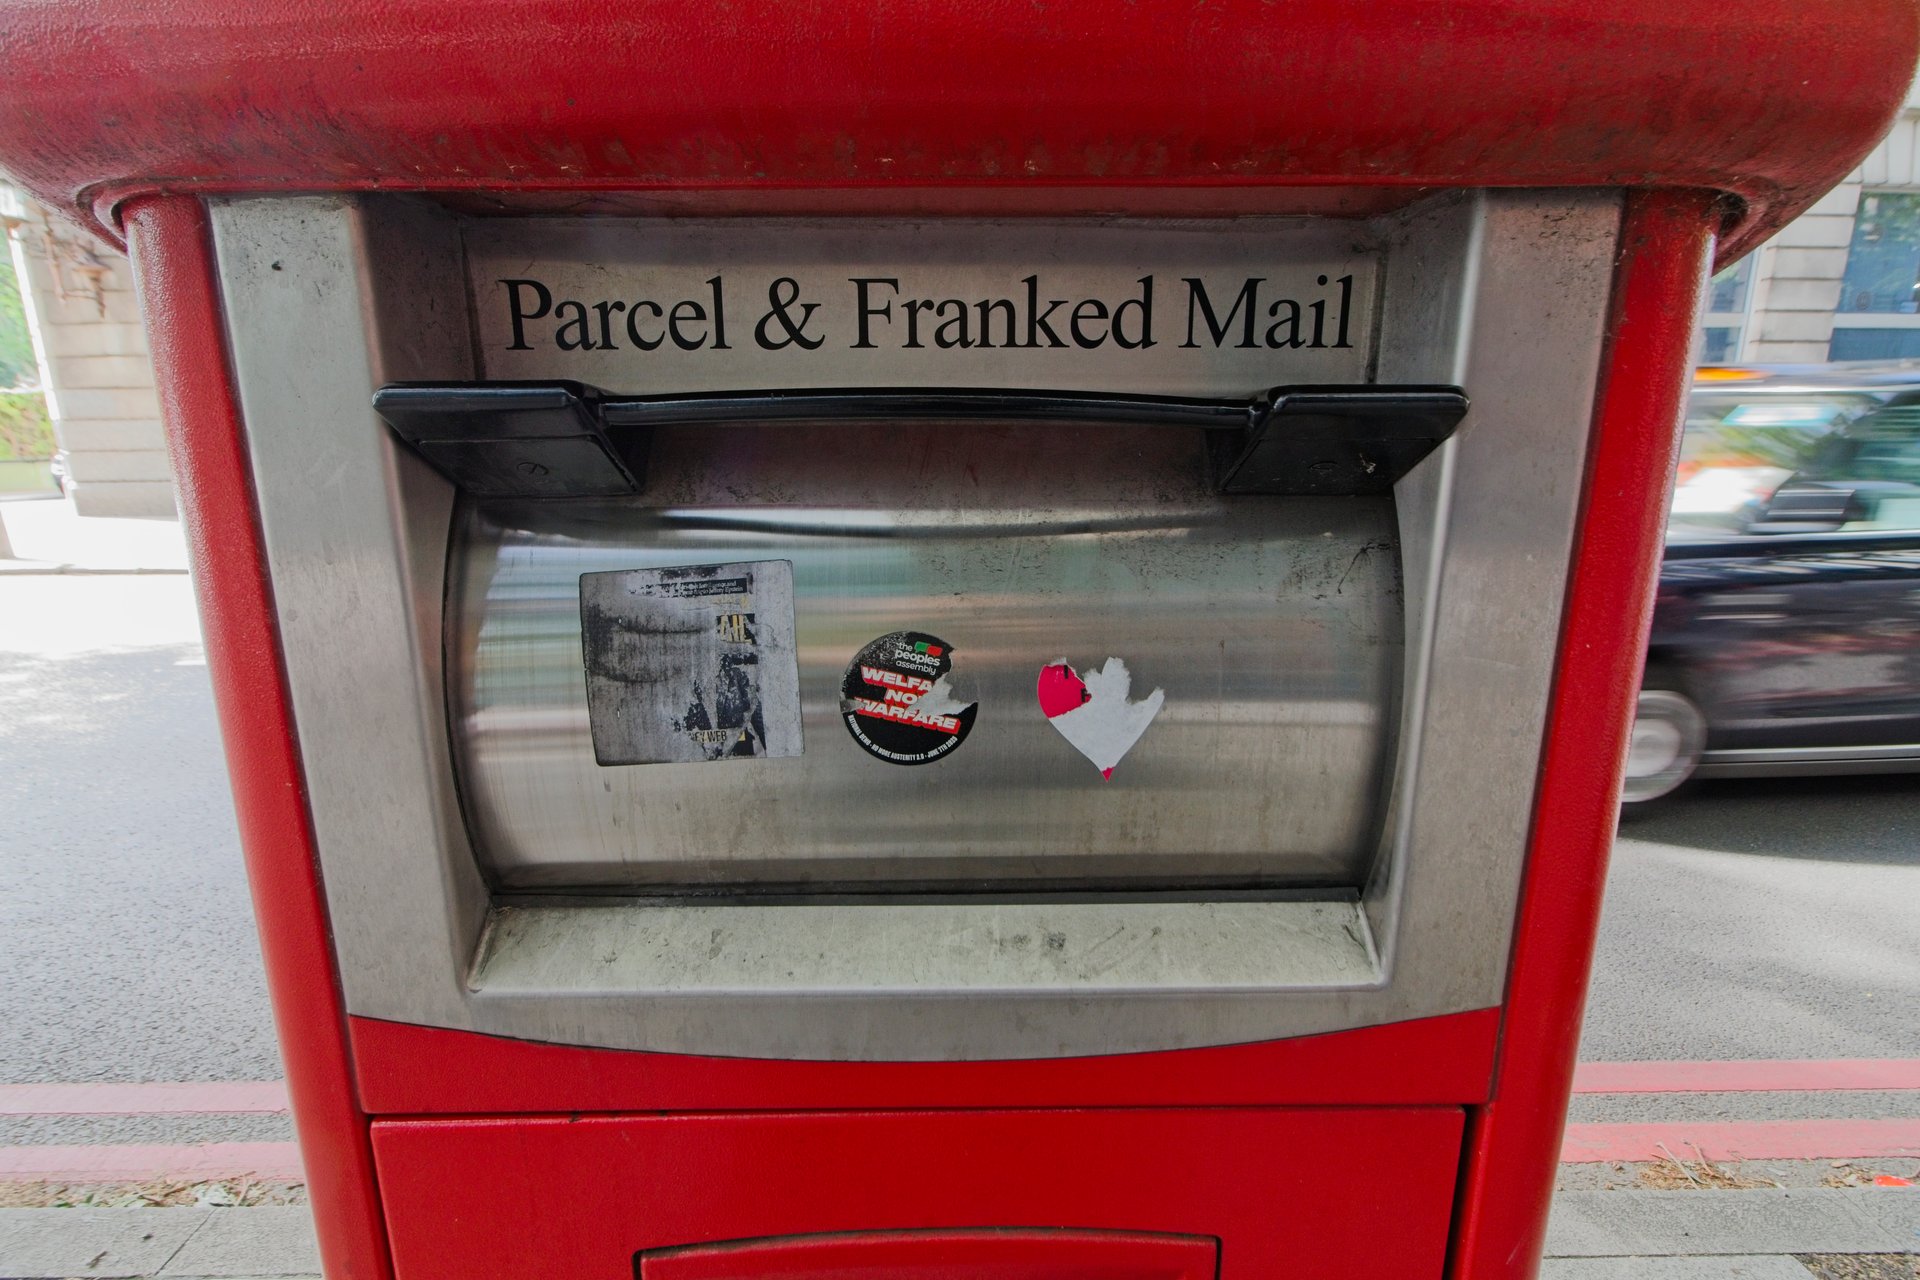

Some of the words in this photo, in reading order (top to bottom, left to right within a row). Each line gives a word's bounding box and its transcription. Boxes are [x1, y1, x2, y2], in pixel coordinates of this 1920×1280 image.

[498, 275, 732, 351] Parcel
[754, 277, 826, 350] &
[848, 275, 1157, 350] Franked
[1178, 275, 1353, 350] Mail
[897, 641, 913, 652] the
[895, 650, 941, 667] peoples
[895, 660, 937, 676] assembly
[862, 666, 934, 692] WELFA
[859, 733, 871, 746] DEMO
[871, 744, 879, 752] NO
[878, 747, 891, 758] MORE
[890, 752, 916, 761] AUSTERITY
[928, 748, 939, 758] JUNE
